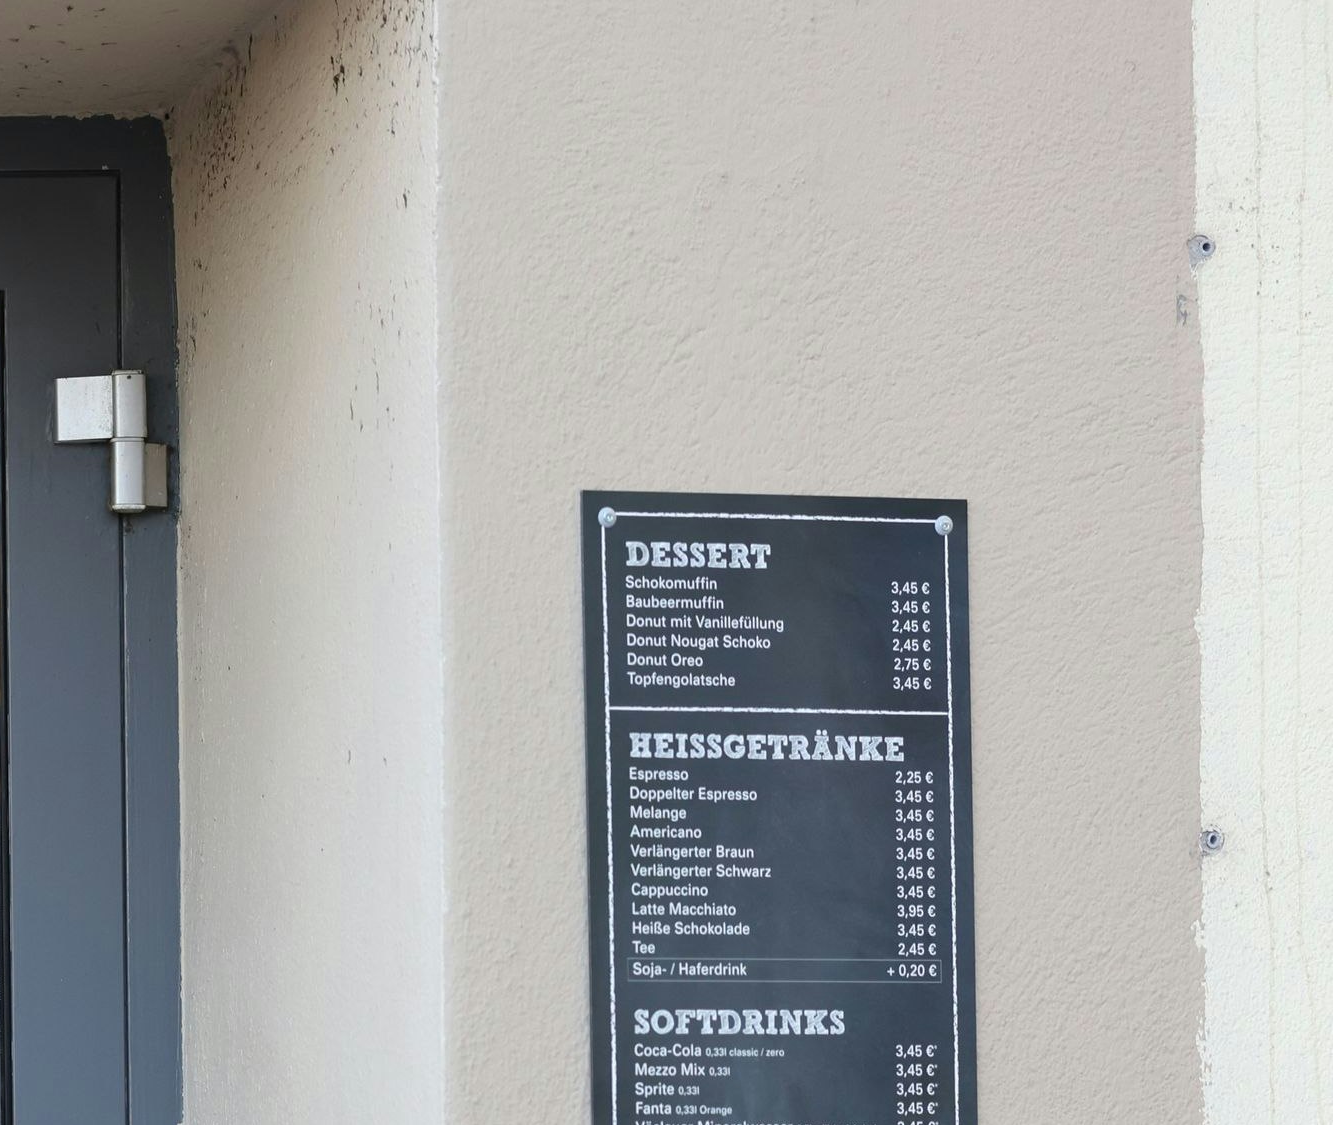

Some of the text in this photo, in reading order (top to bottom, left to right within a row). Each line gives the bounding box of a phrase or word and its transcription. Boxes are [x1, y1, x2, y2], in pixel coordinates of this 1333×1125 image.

[625, 540, 771, 569] DESSERT
[625, 574, 717, 590] Schokomuffin
[890, 580, 918, 597] 3,45
[625, 593, 724, 610] Baubeermuffin
[626, 612, 784, 633] Donut mit Vanillefüllung
[891, 619, 920, 634] 2,45
[626, 651, 703, 667] Donut Oreo
[626, 671, 735, 688] Topfengolatsche
[628, 729, 904, 762] HEISSGETRÄNKE
[628, 766, 689, 783] Espresso
[629, 804, 686, 822] Melange
[629, 823, 702, 839] Americano
[631, 881, 708, 899] Cappuccino
[631, 901, 736, 916] Latte Macchiato
[631, 920, 750, 935] Heiße Schokolade
[633, 1008, 845, 1035] SOFTDRINKS
[633, 1042, 701, 1057] Coca-Cola
[705, 1046, 727, 1057] 0,33l
